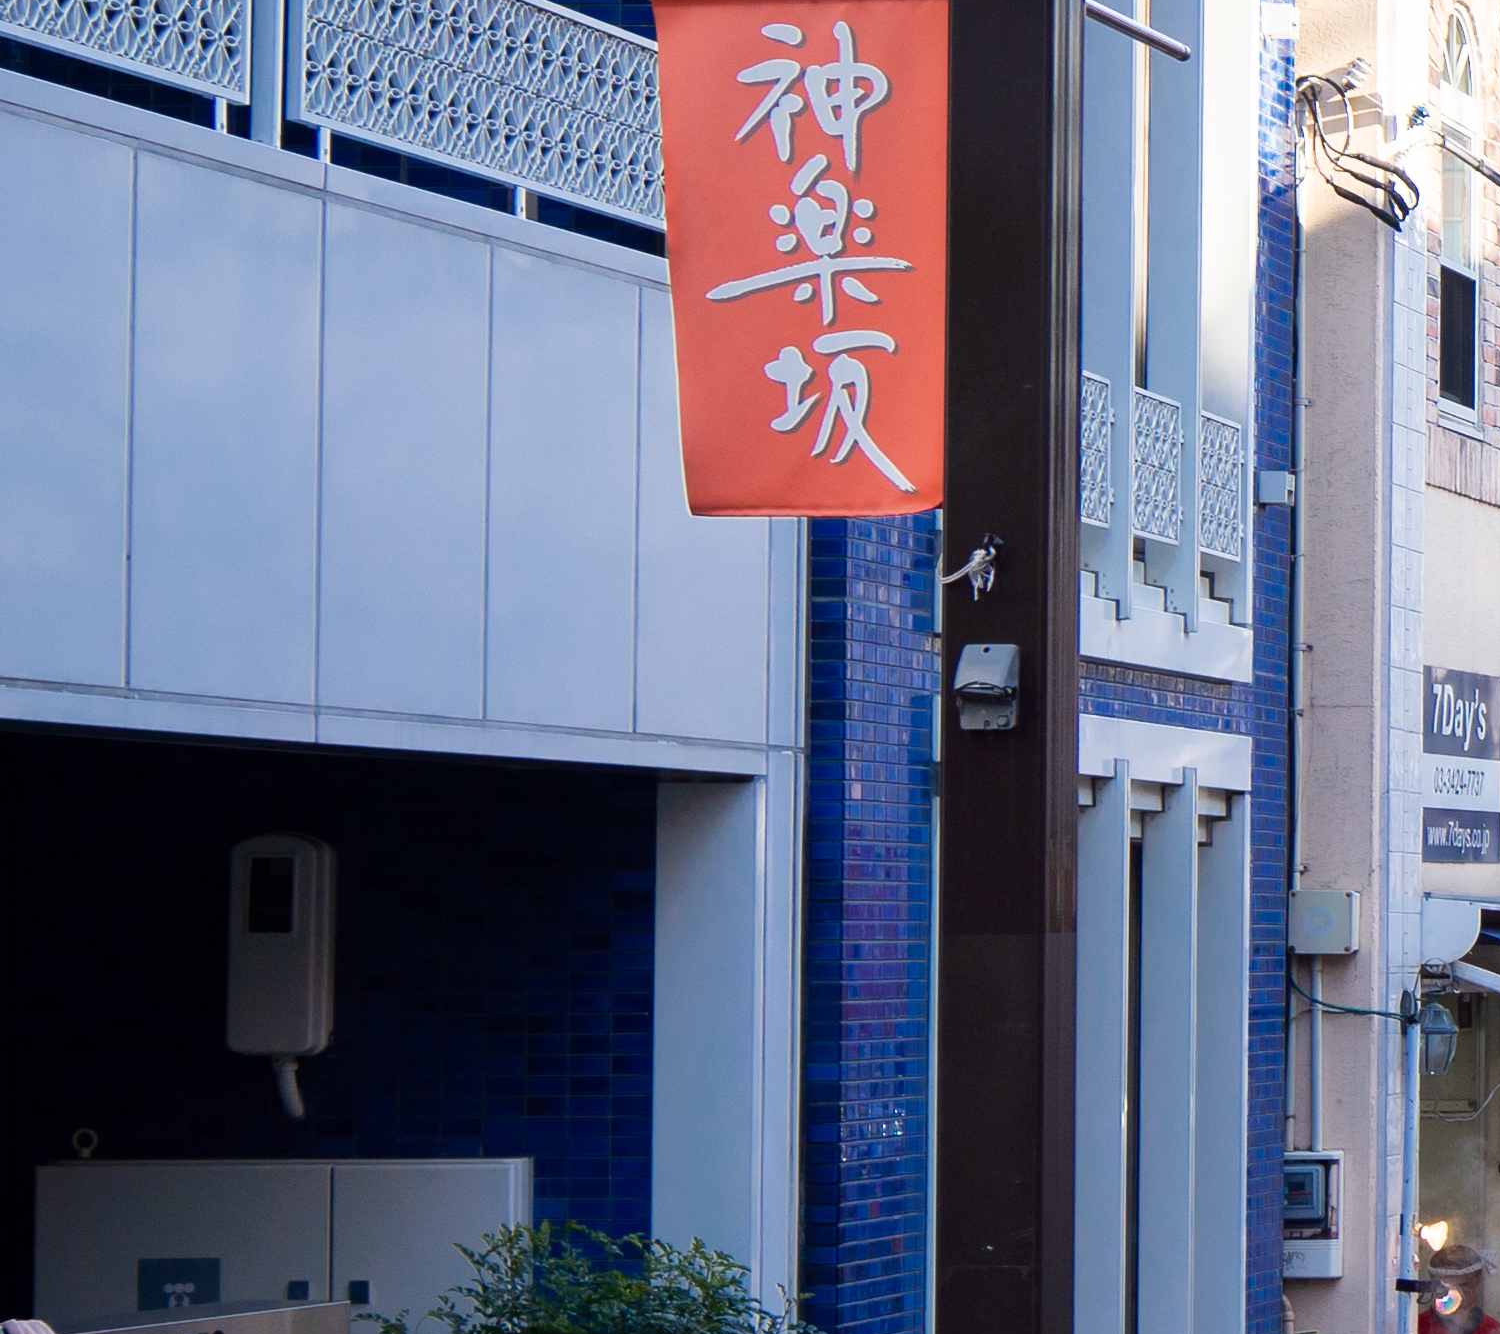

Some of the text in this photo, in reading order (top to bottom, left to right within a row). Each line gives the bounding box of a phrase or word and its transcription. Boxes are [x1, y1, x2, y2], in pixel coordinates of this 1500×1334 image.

[704, 20, 917, 494] 神楽坂
[1431, 682, 1488, 752] 7Day's
[1426, 820, 1491, 855] www.7days.co.jp
